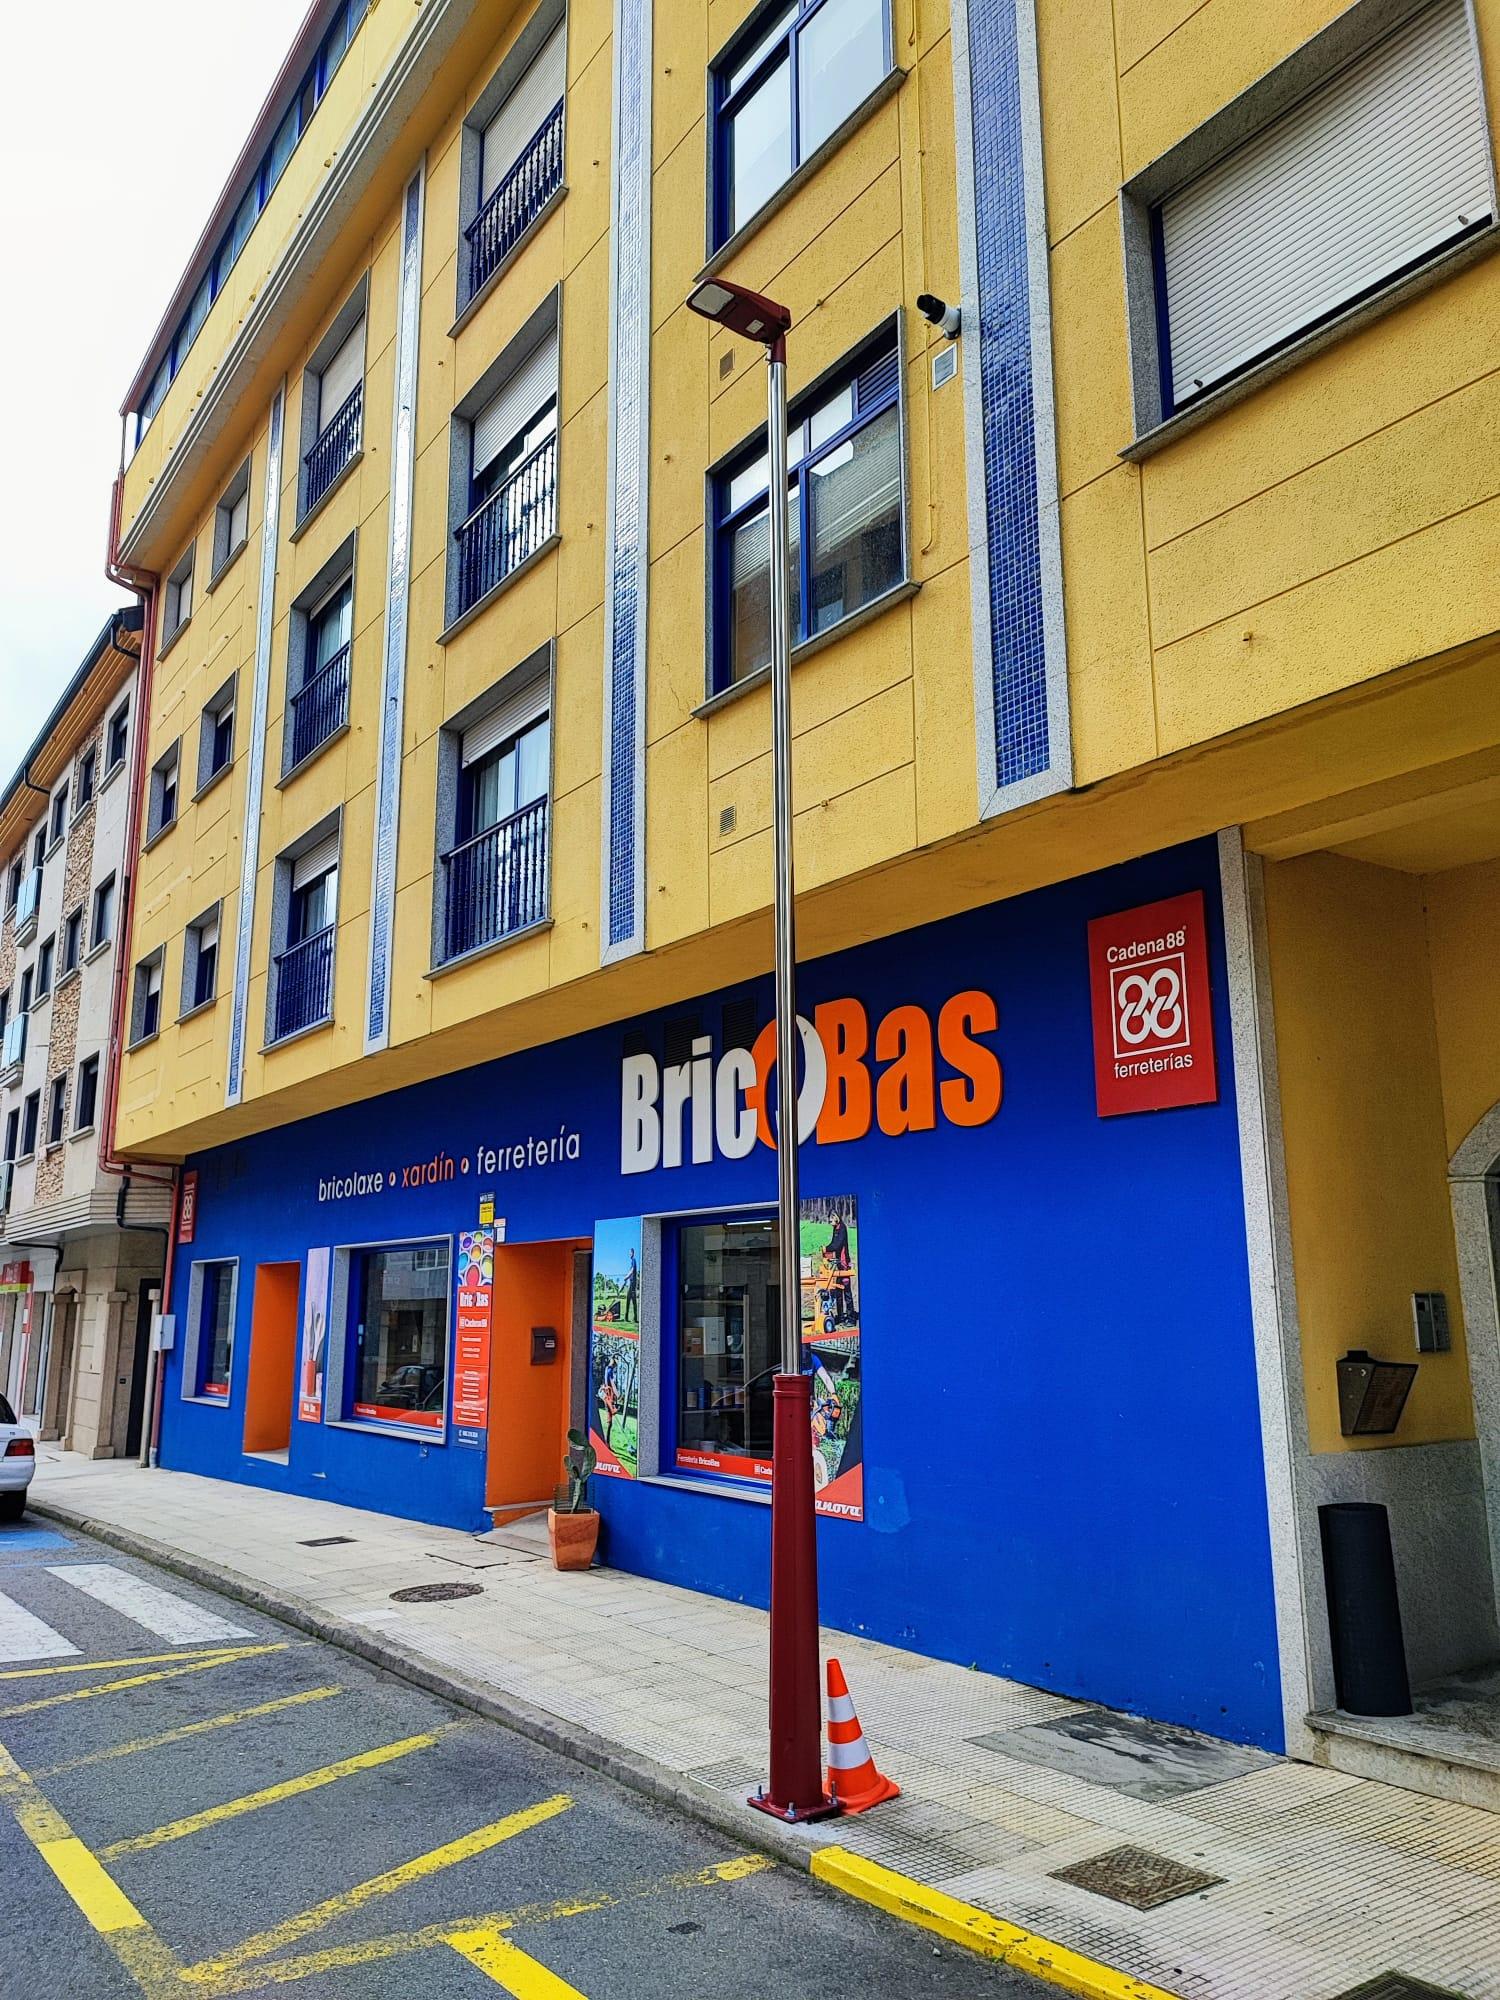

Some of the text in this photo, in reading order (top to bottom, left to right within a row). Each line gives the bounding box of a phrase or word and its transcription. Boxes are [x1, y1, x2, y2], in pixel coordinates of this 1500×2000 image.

[1114, 1053, 1193, 1079] ferreterías
[318, 1125, 581, 1202] bricolaxe xardín ferretería
